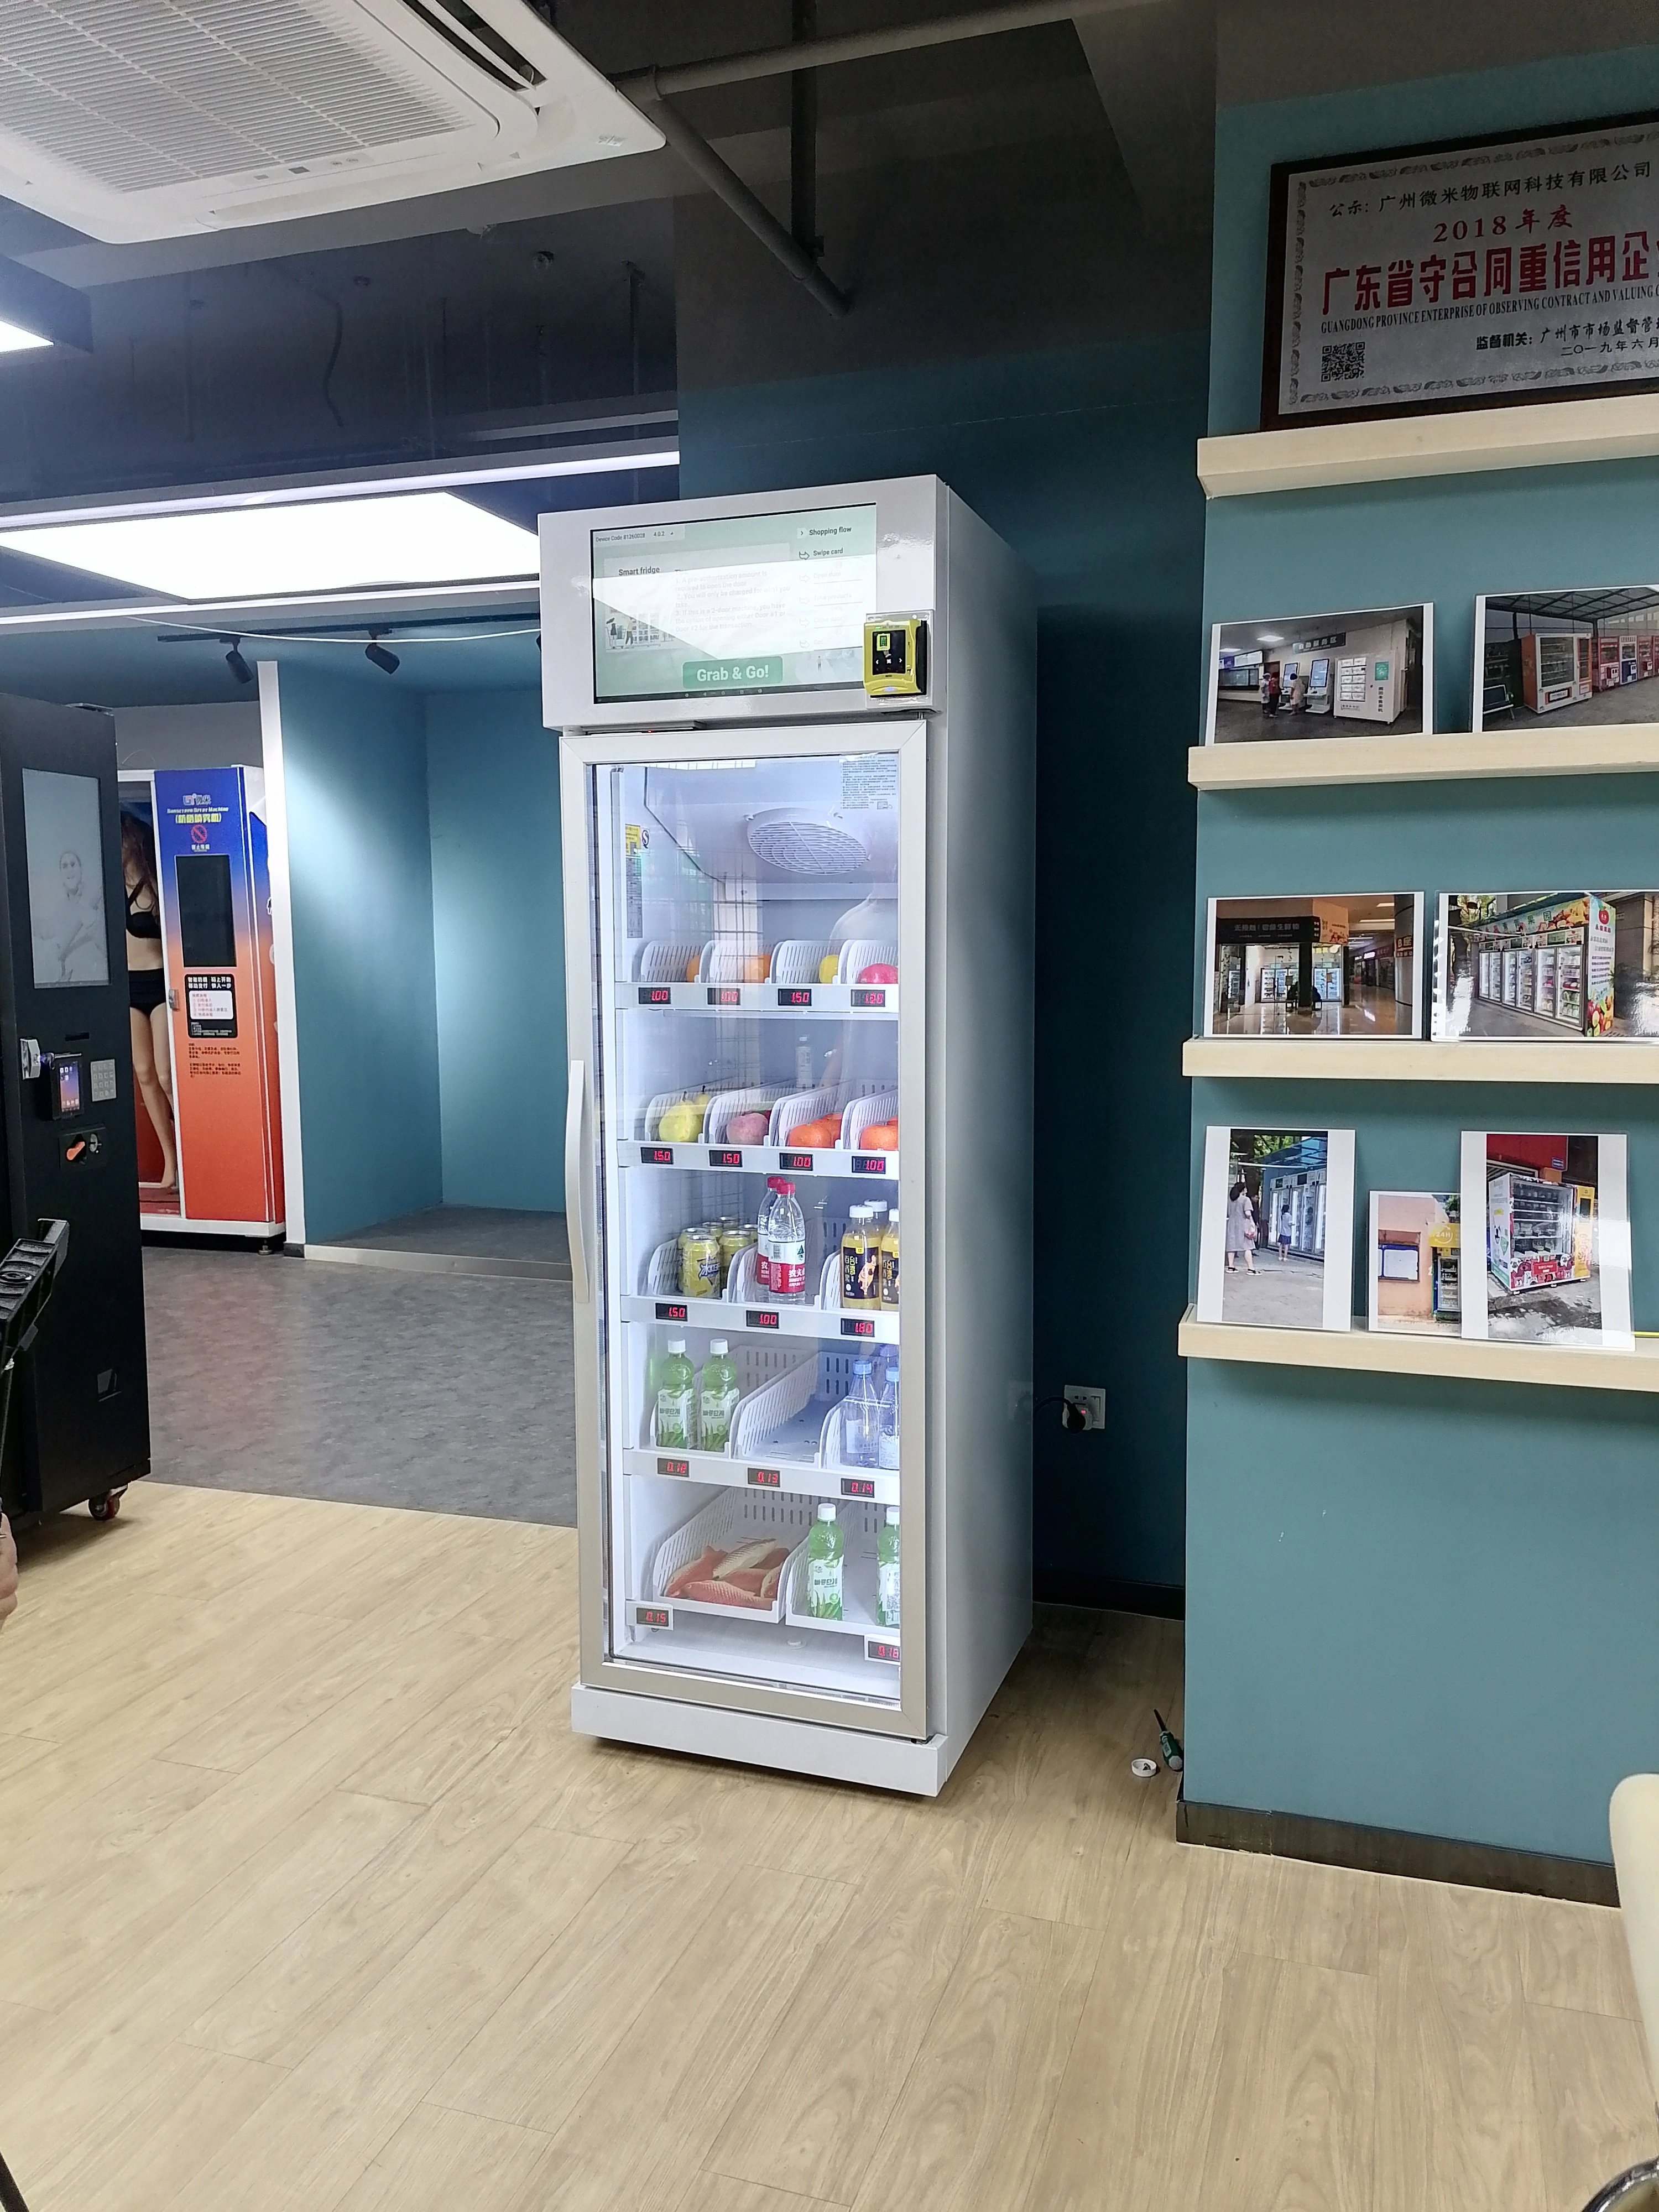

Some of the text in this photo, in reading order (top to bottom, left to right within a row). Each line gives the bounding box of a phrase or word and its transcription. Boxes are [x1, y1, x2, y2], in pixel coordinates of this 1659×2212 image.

[1322, 230, 1659, 316] 广东省守合同重信用企
[1321, 316, 1374, 333] GUANGDONG
[1376, 311, 1420, 328] PROVINCE
[1421, 305, 1475, 322] ENTERPRISE
[1476, 303, 1488, 317] OF
[1489, 297, 1540, 315] OBSERVING
[1541, 291, 1590, 309] CONTRACT
[1592, 290, 1611, 304] AND
[1612, 285, 1653, 301] VALUING
[809, 528, 837, 536] Shopping
[640, 566, 660, 575] fridge
[729, 588, 753, 596] charged
[697, 665, 769, 682] Grab & Go!
